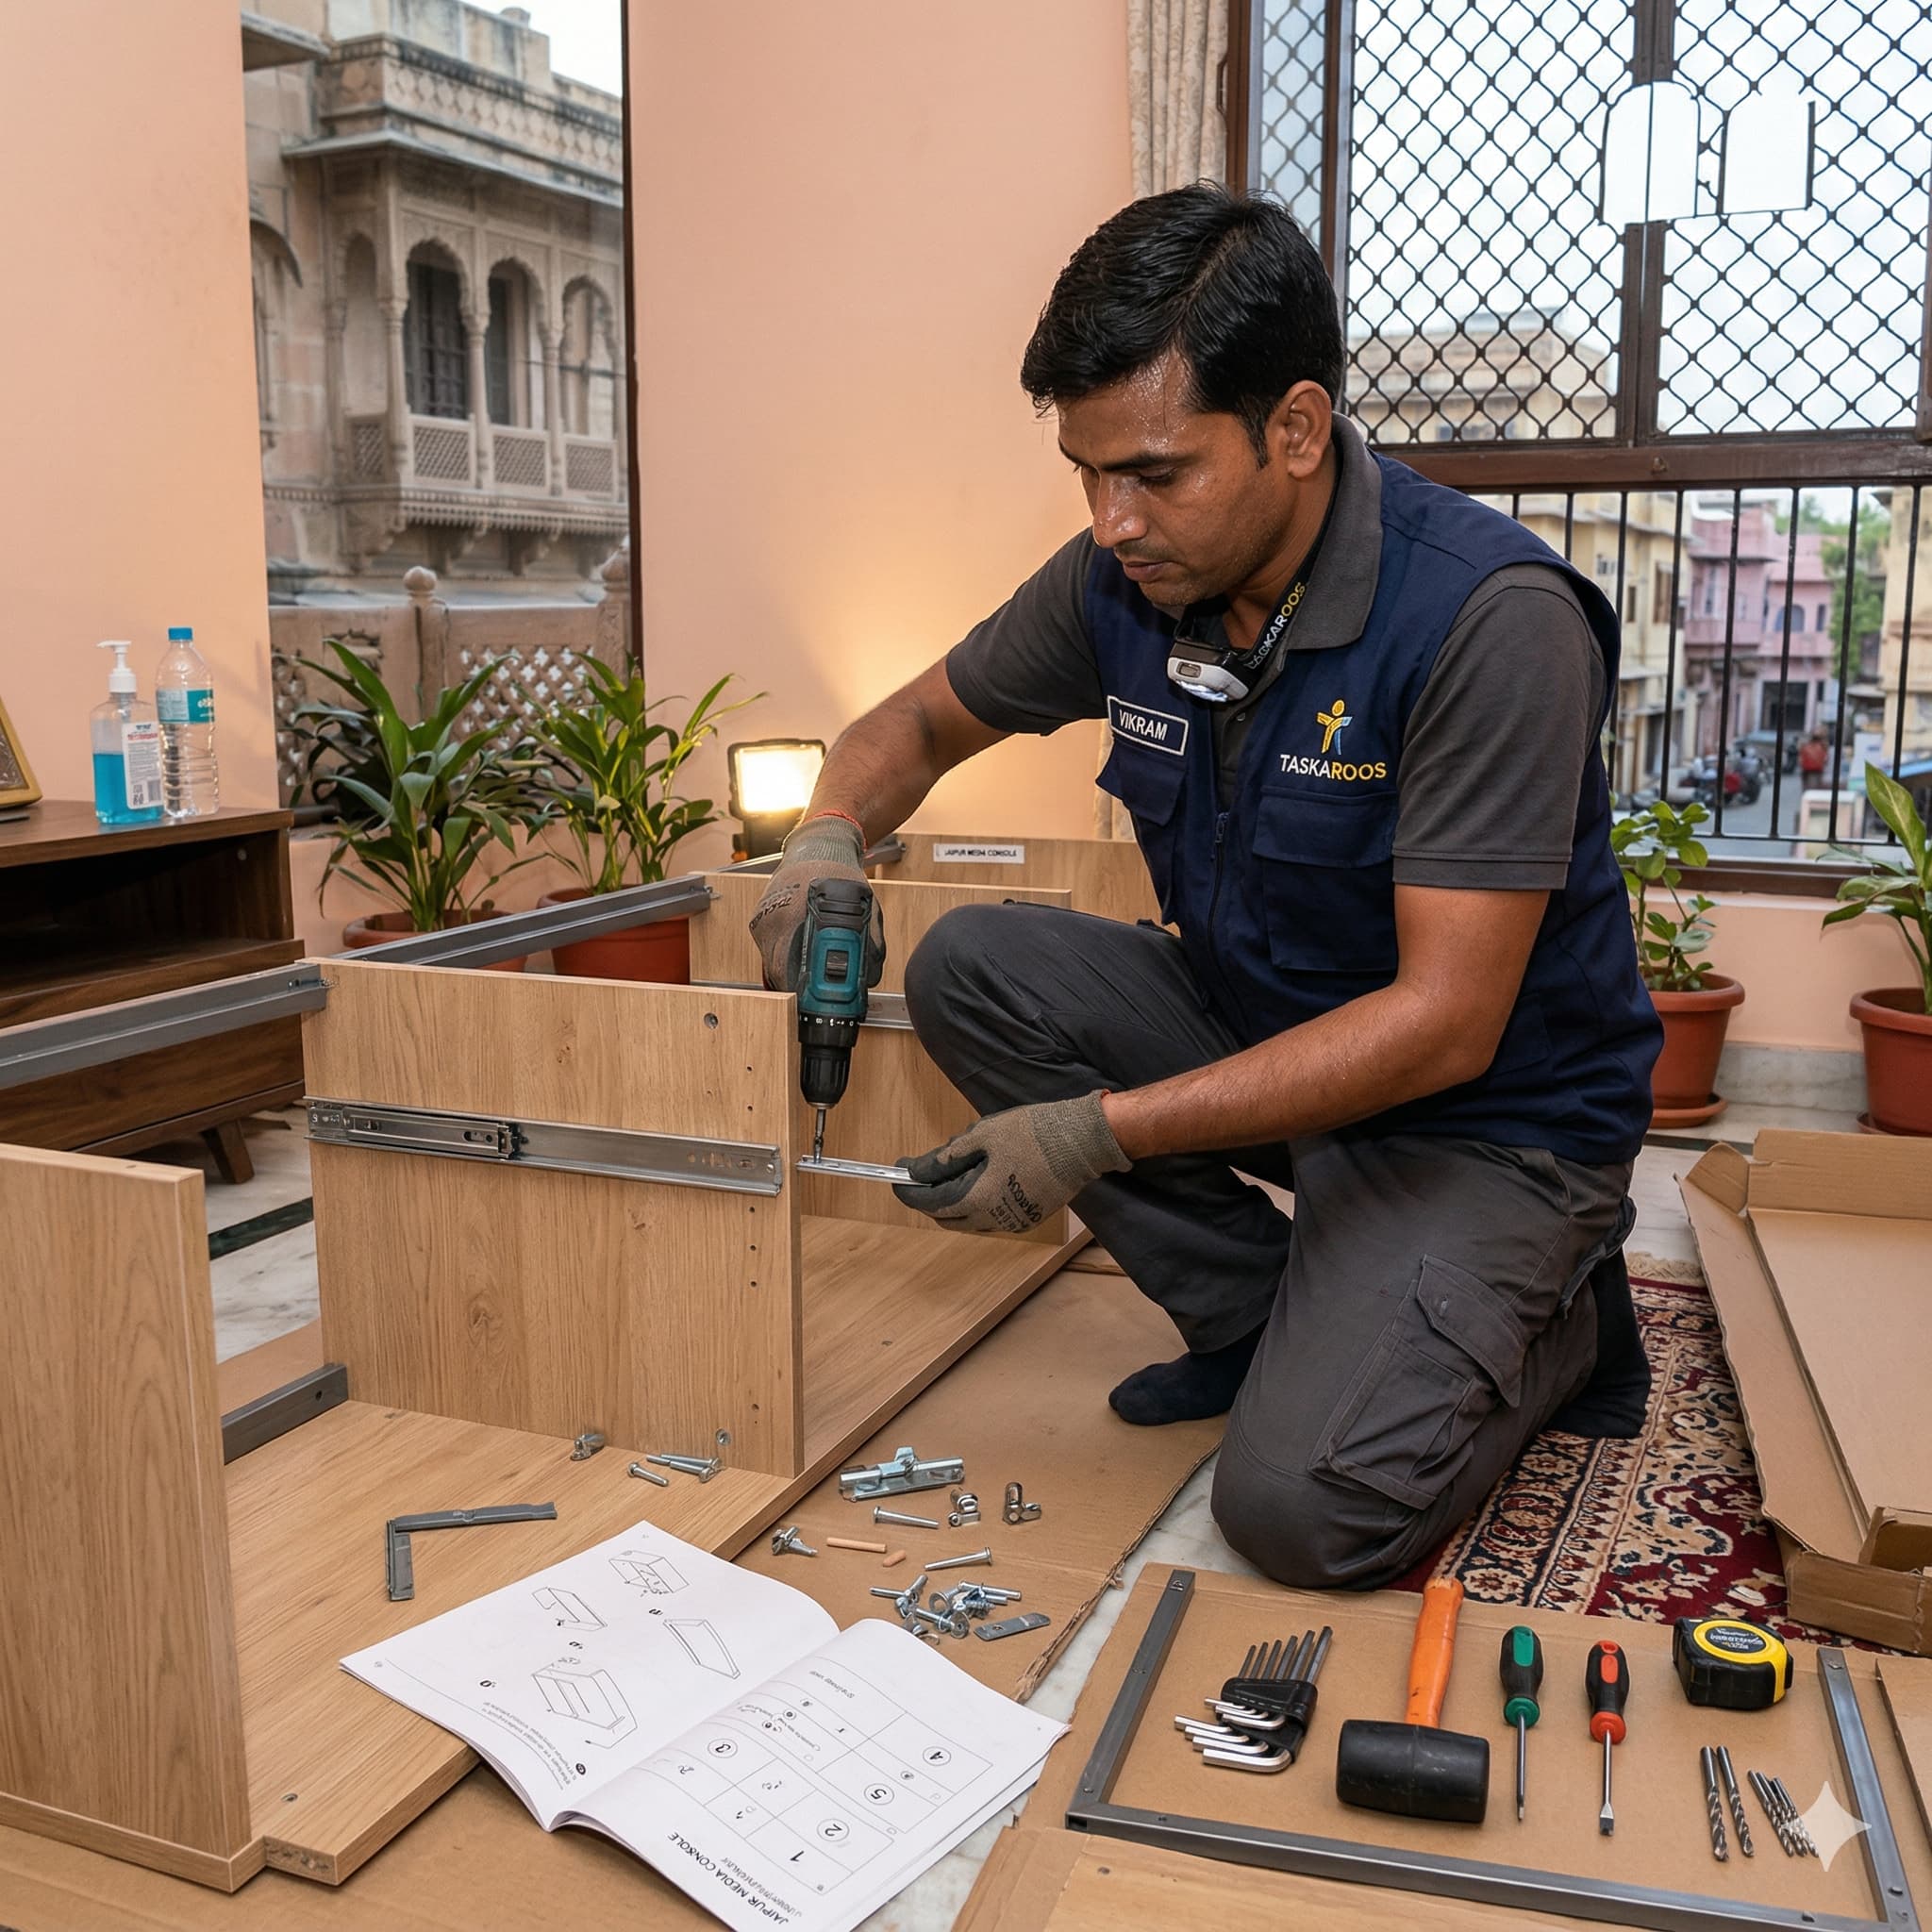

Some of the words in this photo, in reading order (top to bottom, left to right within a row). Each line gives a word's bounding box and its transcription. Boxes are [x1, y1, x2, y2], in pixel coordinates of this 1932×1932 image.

[1119, 709, 1168, 741] VIKRAM
[1280, 754, 1388, 781] TASKAROOS
[747, 1896, 789, 1925] JAIPUR
